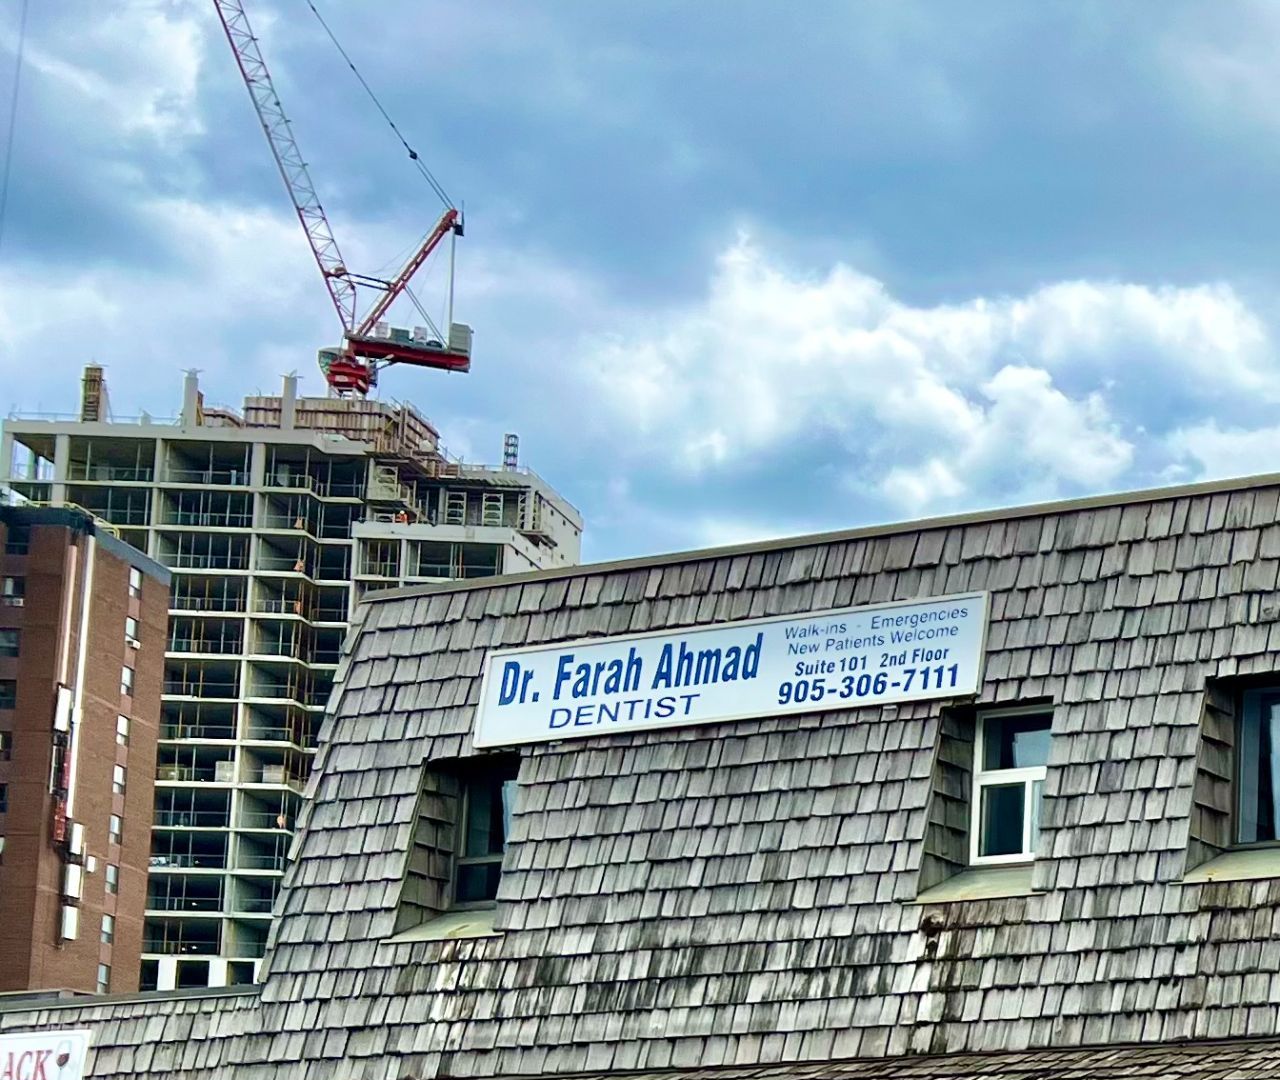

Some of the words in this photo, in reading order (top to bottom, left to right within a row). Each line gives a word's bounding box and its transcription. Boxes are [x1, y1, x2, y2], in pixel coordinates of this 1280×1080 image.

[785, 622, 847, 639] Walk-ins
[871, 607, 968, 629] Emergencies
[788, 642, 820, 655] New
[825, 634, 885, 652] Patients
[890, 625, 959, 644] Welcome
[498, 661, 539, 706] Dr.
[553, 647, 643, 700] Farah
[651, 632, 764, 690] Ahmad
[795, 658, 835, 676] Suite
[840, 656, 867, 672] 101
[880, 651, 906, 667] 2nd
[912, 647, 949, 664] Floor
[778, 663, 959, 705] 905-306-7111
[549, 693, 701, 729] DENTIST
